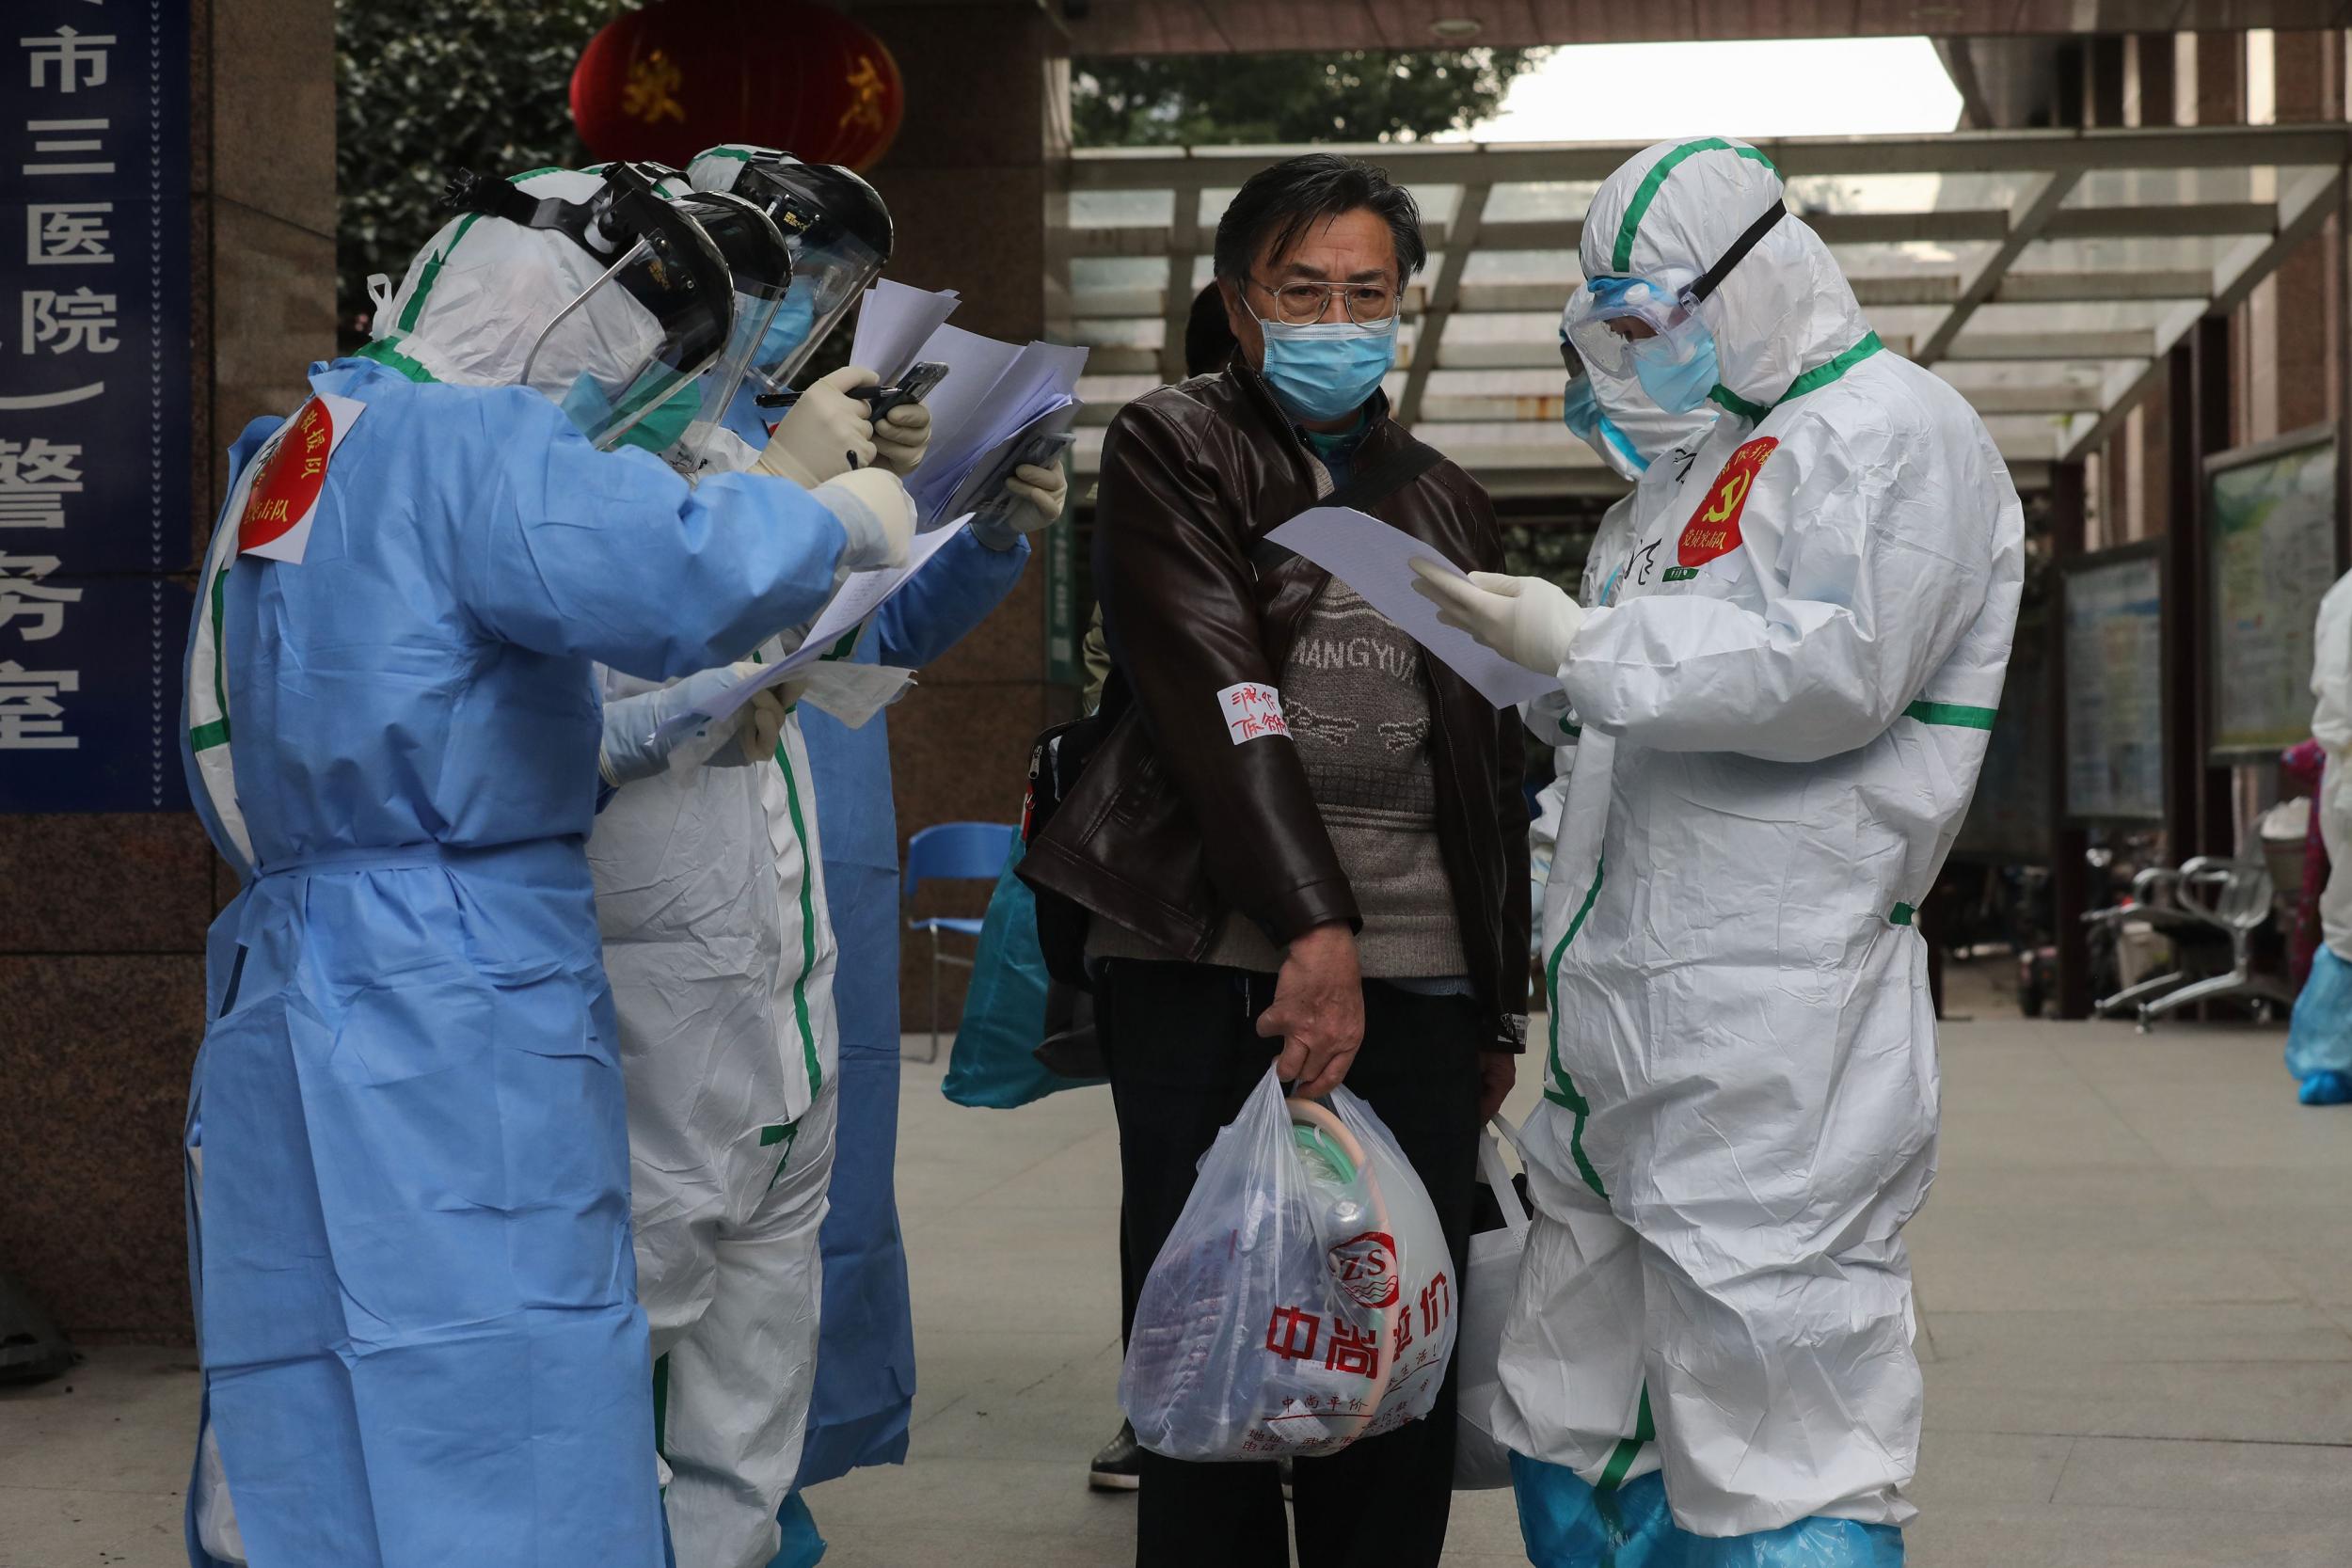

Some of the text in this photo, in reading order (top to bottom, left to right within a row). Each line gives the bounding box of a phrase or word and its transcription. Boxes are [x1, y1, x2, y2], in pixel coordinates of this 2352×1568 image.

[1340, 1248, 1387, 1280] ZS
[1281, 1396, 1369, 1415] 中尚平价
